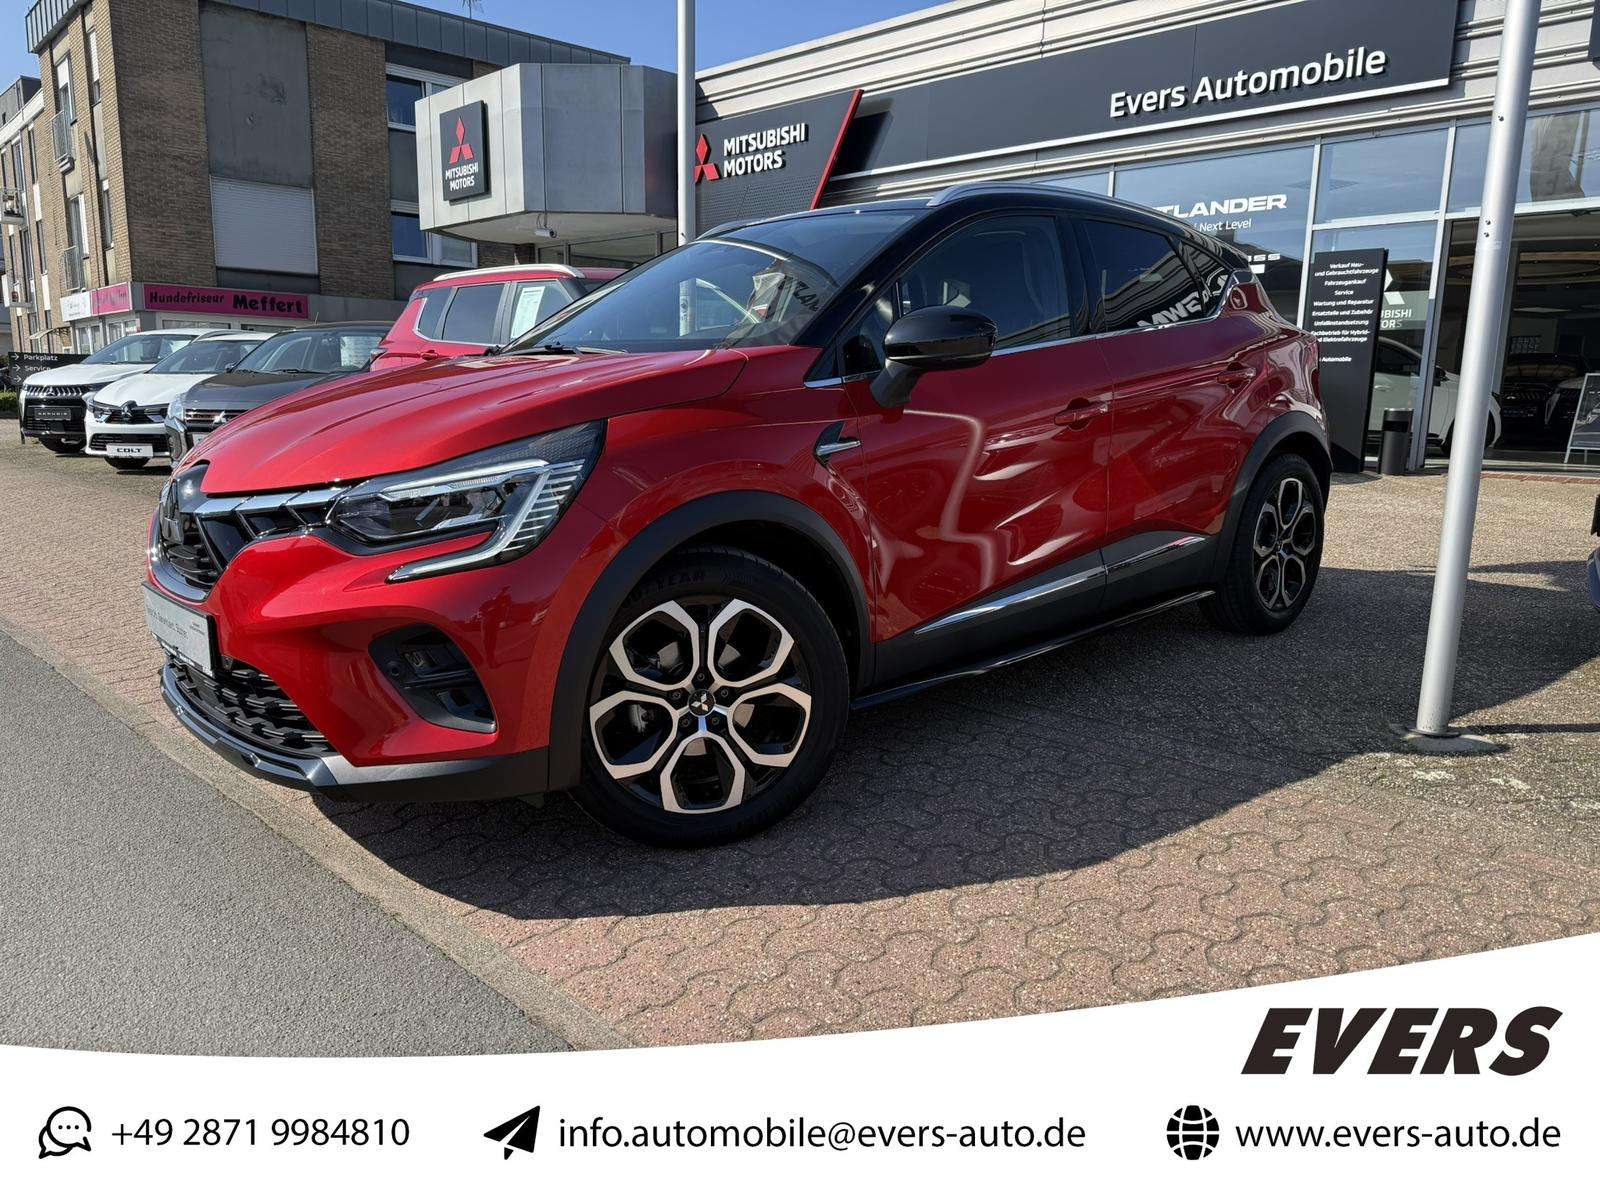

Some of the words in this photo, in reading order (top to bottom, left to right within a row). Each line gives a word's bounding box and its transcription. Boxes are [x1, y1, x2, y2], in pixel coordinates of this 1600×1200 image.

[1109, 85, 1186, 118] Evers
[1192, 47, 1386, 104] Automobile
[723, 122, 806, 157] MITSUBISHI
[445, 161, 479, 180] MITSUBISHI
[723, 149, 783, 178] MOTORS
[450, 175, 475, 191] MOTORS
[1153, 194, 1287, 219] TLANDER
[1199, 221, 1223, 232] Next
[1225, 218, 1252, 230] Level
[150, 292, 225, 304] Hundefriseur
[232, 294, 303, 314] Meffert
[23, 354, 58, 362] Parkplatz
